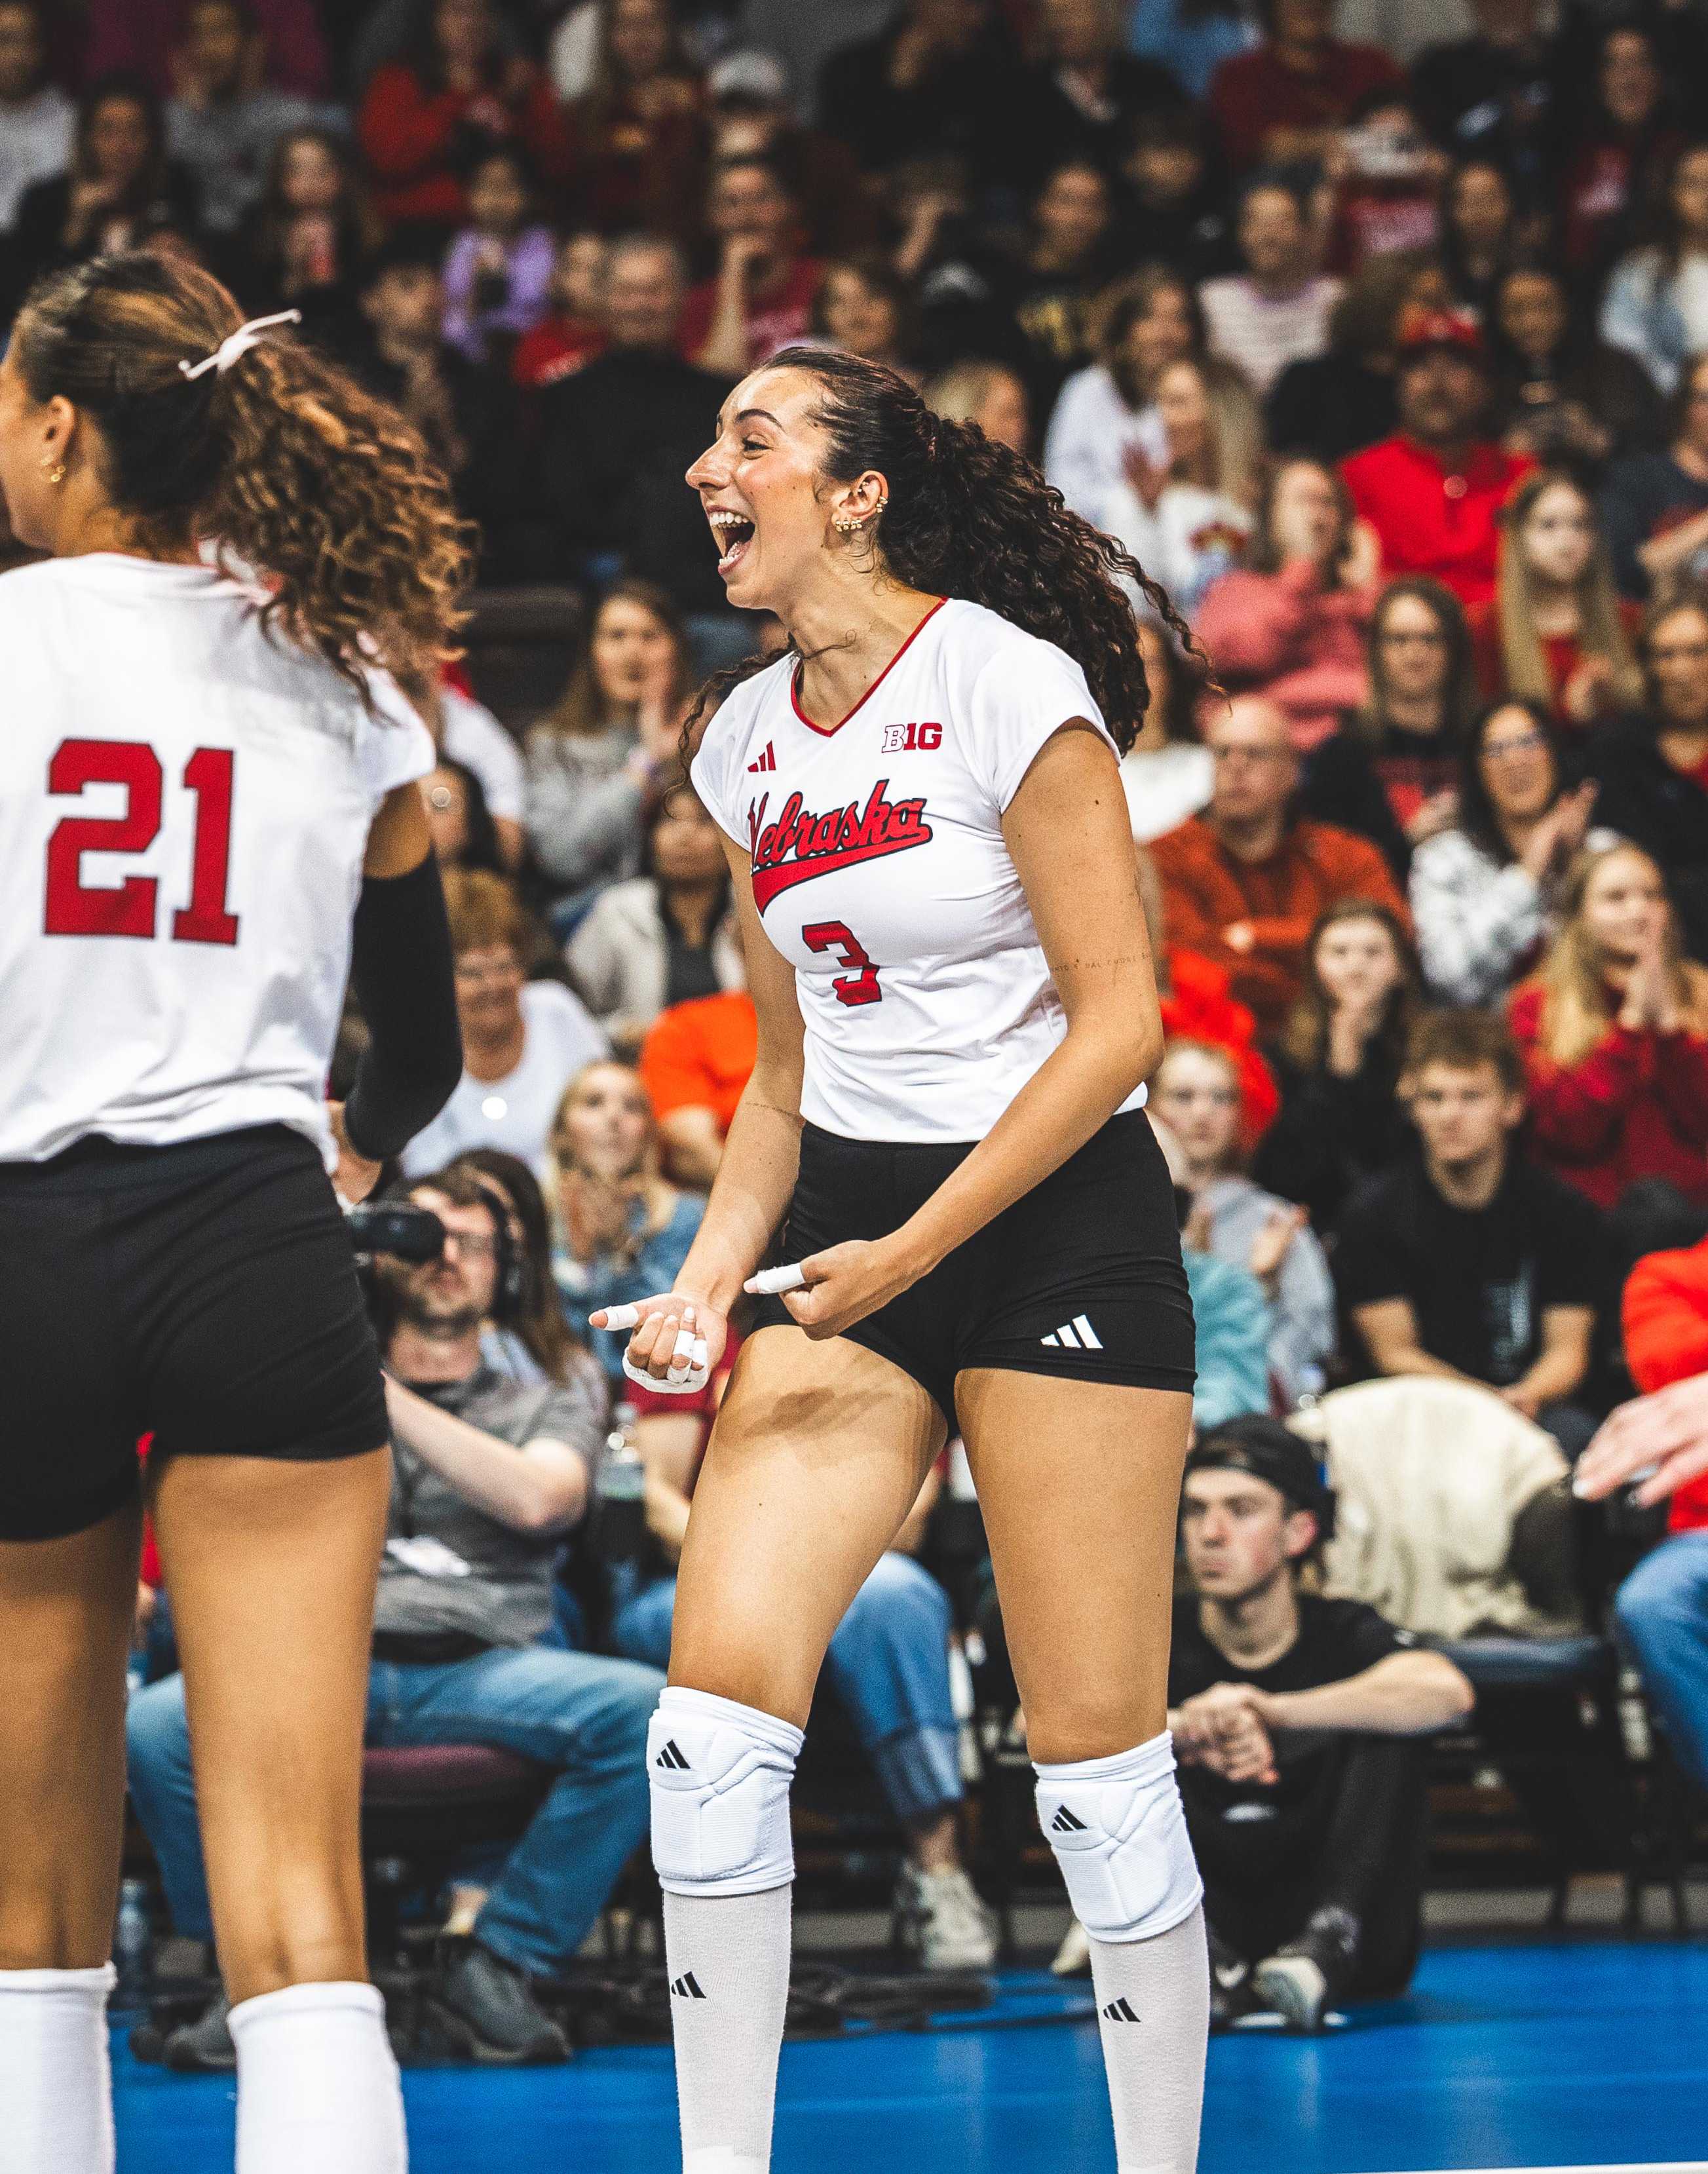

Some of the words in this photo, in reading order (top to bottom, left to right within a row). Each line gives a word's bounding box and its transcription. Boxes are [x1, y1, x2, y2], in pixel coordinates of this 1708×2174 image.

[43, 738, 240, 946] 21
[748, 778, 931, 877] Nebraska
[801, 920, 882, 1007] 3
